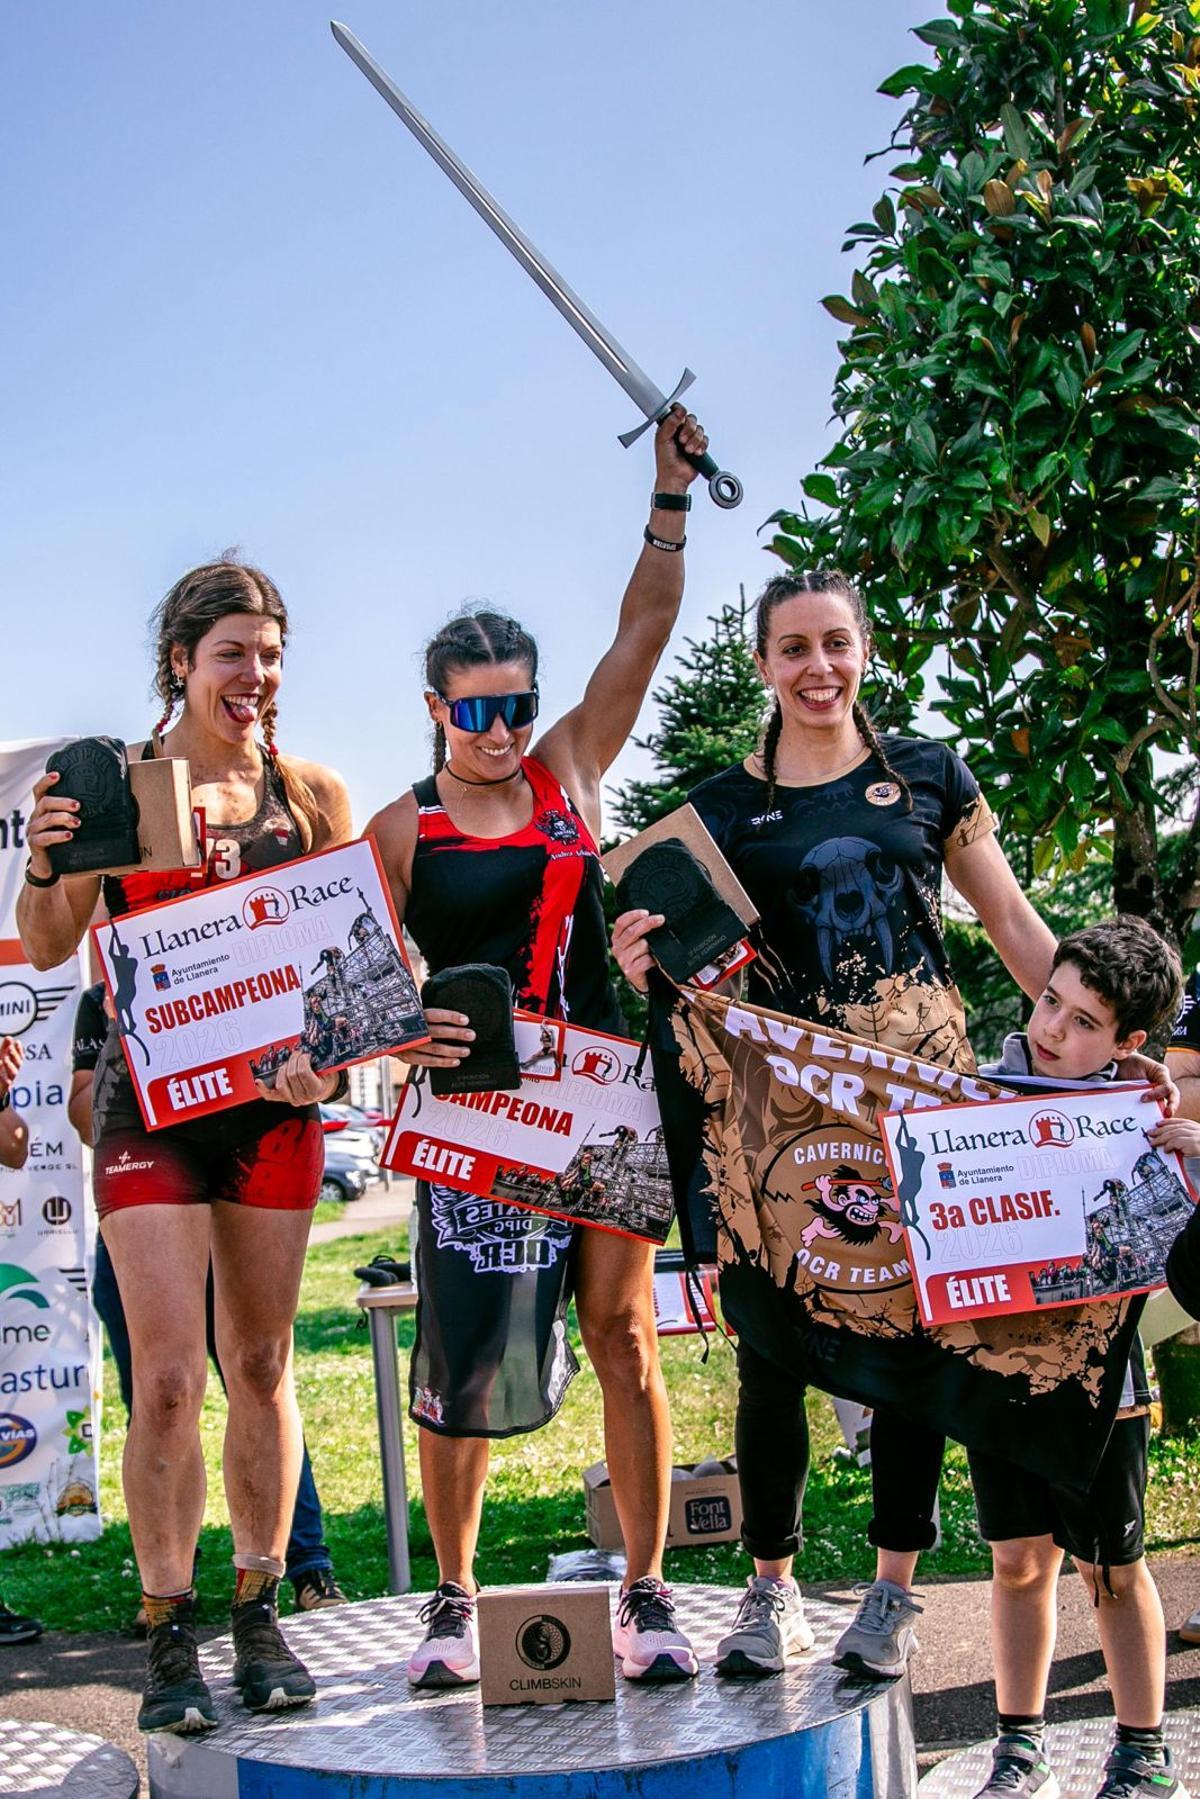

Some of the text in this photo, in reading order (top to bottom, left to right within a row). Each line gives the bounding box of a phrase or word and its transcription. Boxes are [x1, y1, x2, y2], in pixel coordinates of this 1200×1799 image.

[139, 876, 356, 961] Llanera Race
[232, 914, 334, 967] DIPLOMA
[171, 953, 230, 978] Ayuntamiento
[173, 966, 220, 986] de Llanera
[144, 964, 302, 1034] SUBCAMPEONA
[154, 1016, 243, 1072] 2026
[166, 1068, 233, 1112] ÉLITE
[928, 1114, 1138, 1155] Llanera Race
[105, 1161, 155, 1175] TEAMERGY
[411, 1139, 476, 1181] ÉLITE
[957, 1165, 1014, 1179] Ayuntamiento
[1016, 1148, 1114, 1181] DIPLOMA
[959, 1173, 1004, 1186] de Llanera
[930, 1190, 1061, 1231] 3a CLASIF.
[934, 1224, 1024, 1264] 2026
[946, 1274, 1012, 1309] ÉLITE
[690, 1502, 725, 1516] Font
[690, 1514, 728, 1530] Vella
[509, 1676, 582, 1692] CLIMBSKIN
